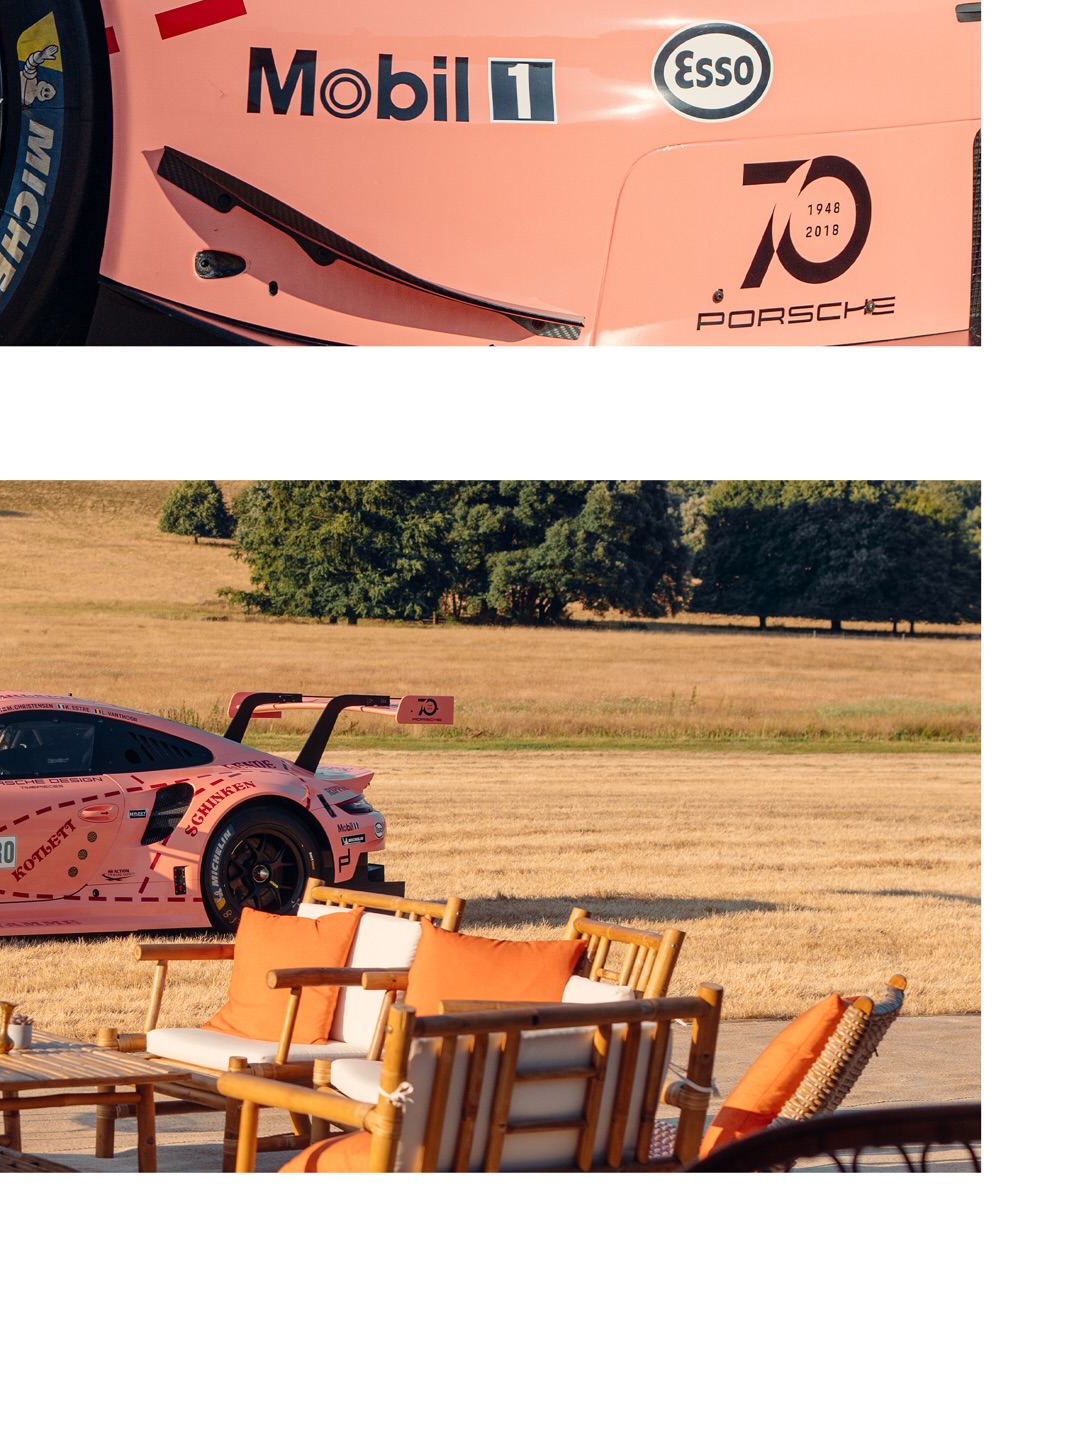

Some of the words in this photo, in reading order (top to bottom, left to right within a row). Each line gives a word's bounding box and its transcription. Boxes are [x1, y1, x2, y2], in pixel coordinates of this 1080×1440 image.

[246, 47, 470, 122] Mobil
[740, 155, 872, 289] 70
[807, 202, 841, 216] 1948
[805, 224, 840, 238] 2018
[696, 296, 896, 331] PORSCHE
[418, 698, 437, 716] 70
[50, 776, 103, 784] DESIGN
[11, 818, 76, 882] KOTLETT
[211, 829, 232, 887] MICHELIN
